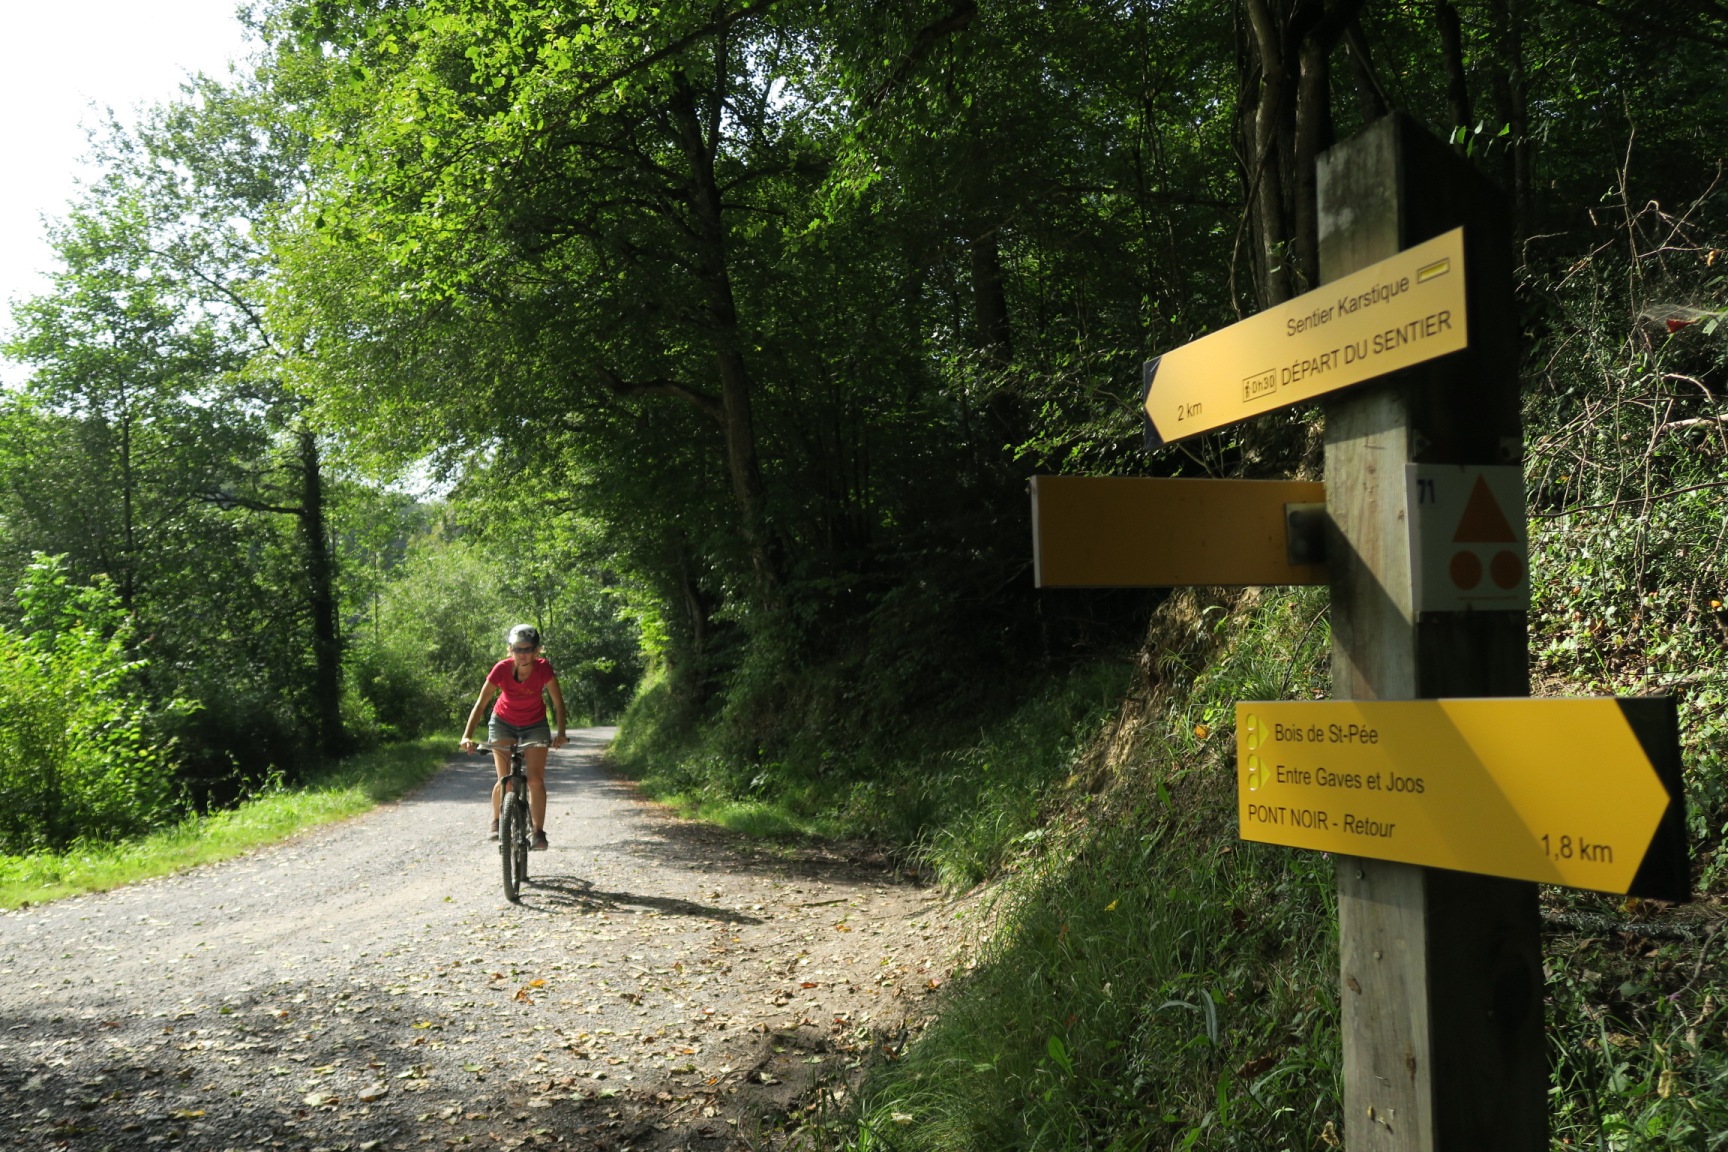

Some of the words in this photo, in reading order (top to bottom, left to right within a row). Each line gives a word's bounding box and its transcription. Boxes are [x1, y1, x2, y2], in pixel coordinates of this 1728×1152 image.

[1287, 304, 1334, 337] Sentier
[1338, 276, 1410, 318] Karstique
[1252, 375, 1275, 393] 0h30
[1281, 349, 1340, 386] DÉPART
[1345, 339, 1368, 365] DU
[1373, 310, 1452, 354] SENTIER
[1177, 405, 1185, 421] 2
[1187, 401, 1202, 418] km
[1417, 479, 1435, 504] 71
[1275, 723, 1303, 742] Bois
[1307, 724, 1324, 742] de
[1329, 724, 1379, 744] St-Pée
[1276, 765, 1311, 786] Entre
[1316, 767, 1362, 789] Gaves
[1367, 772, 1381, 791] et
[1386, 772, 1425, 794] Joos
[1248, 804, 1286, 825] PONT
[1290, 808, 1329, 830] NOIR
[1344, 814, 1396, 838] Retour
[1541, 834, 1573, 863] 1,8
[1580, 836, 1613, 863] km
